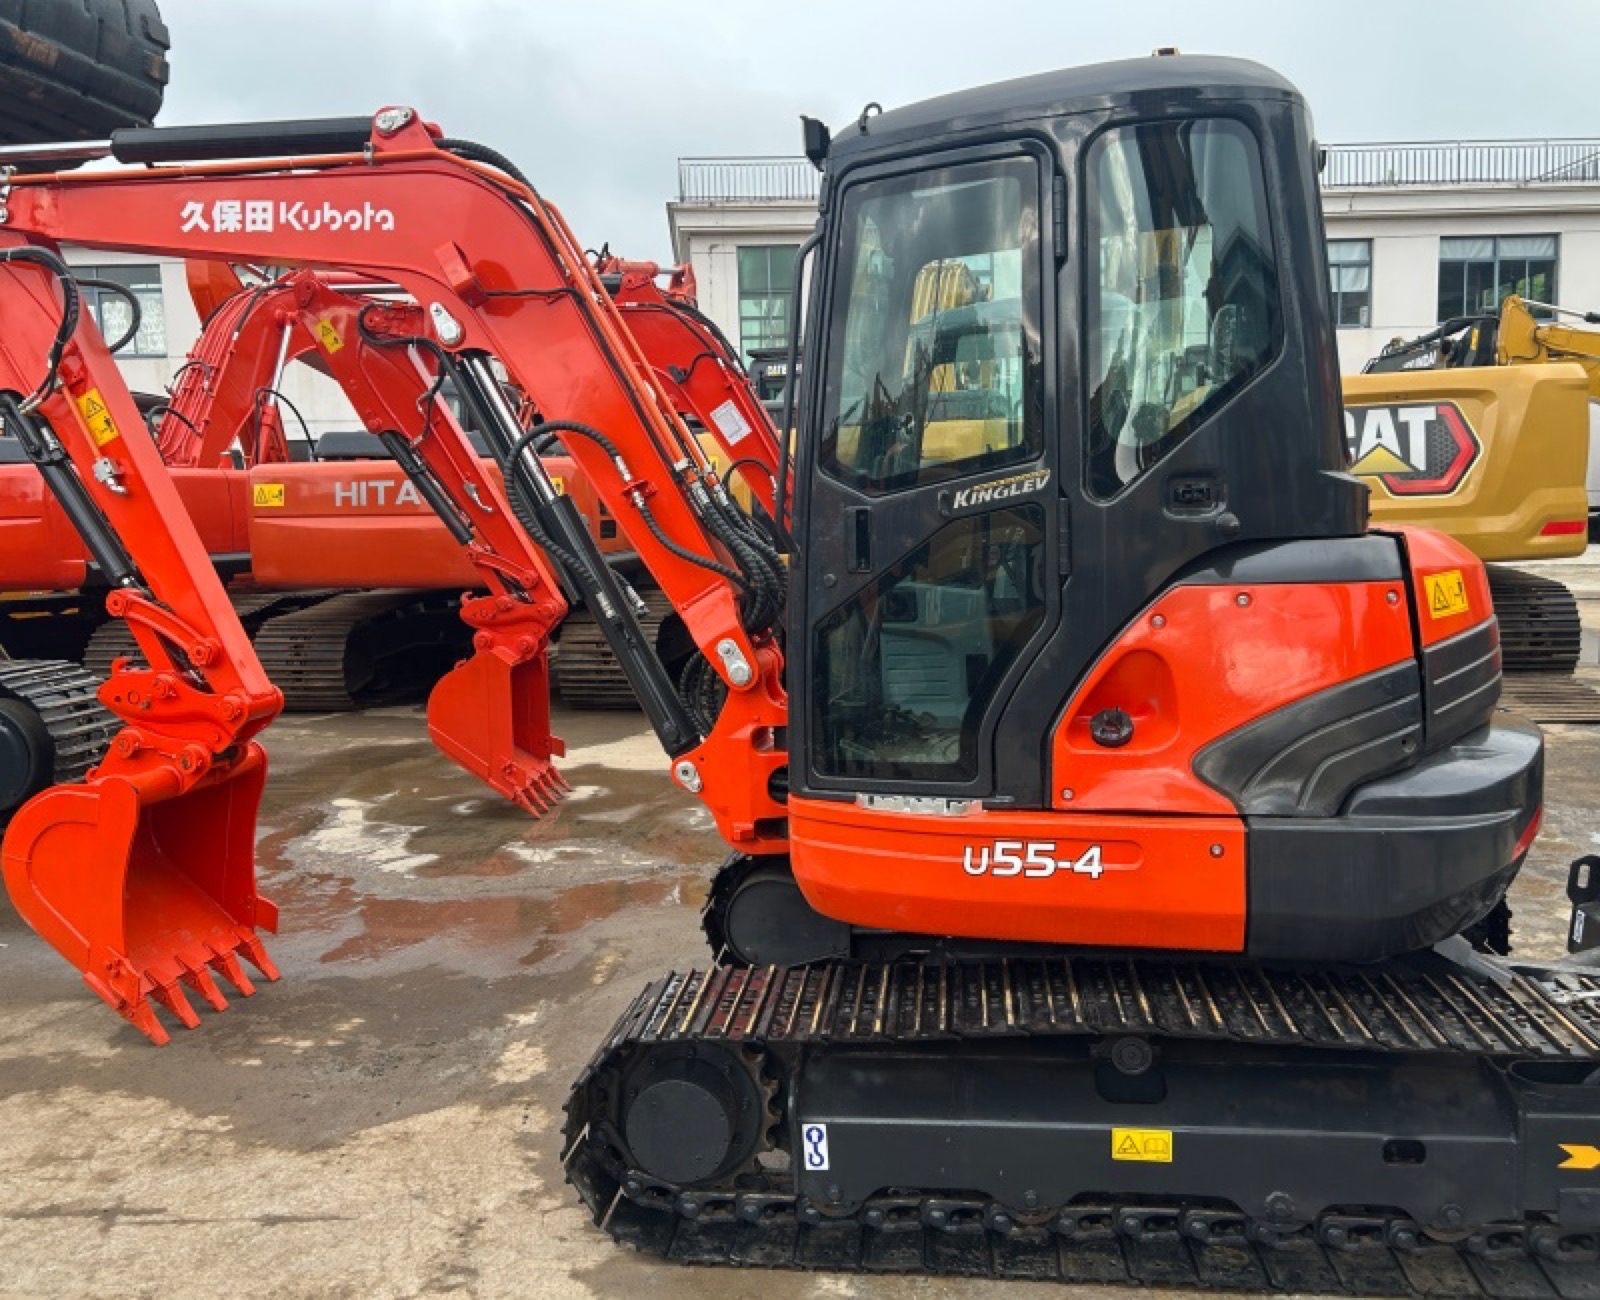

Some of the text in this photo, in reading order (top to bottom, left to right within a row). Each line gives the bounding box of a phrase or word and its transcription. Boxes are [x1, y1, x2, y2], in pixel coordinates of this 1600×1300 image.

[179, 200, 395, 233] 久保田 Kubota
